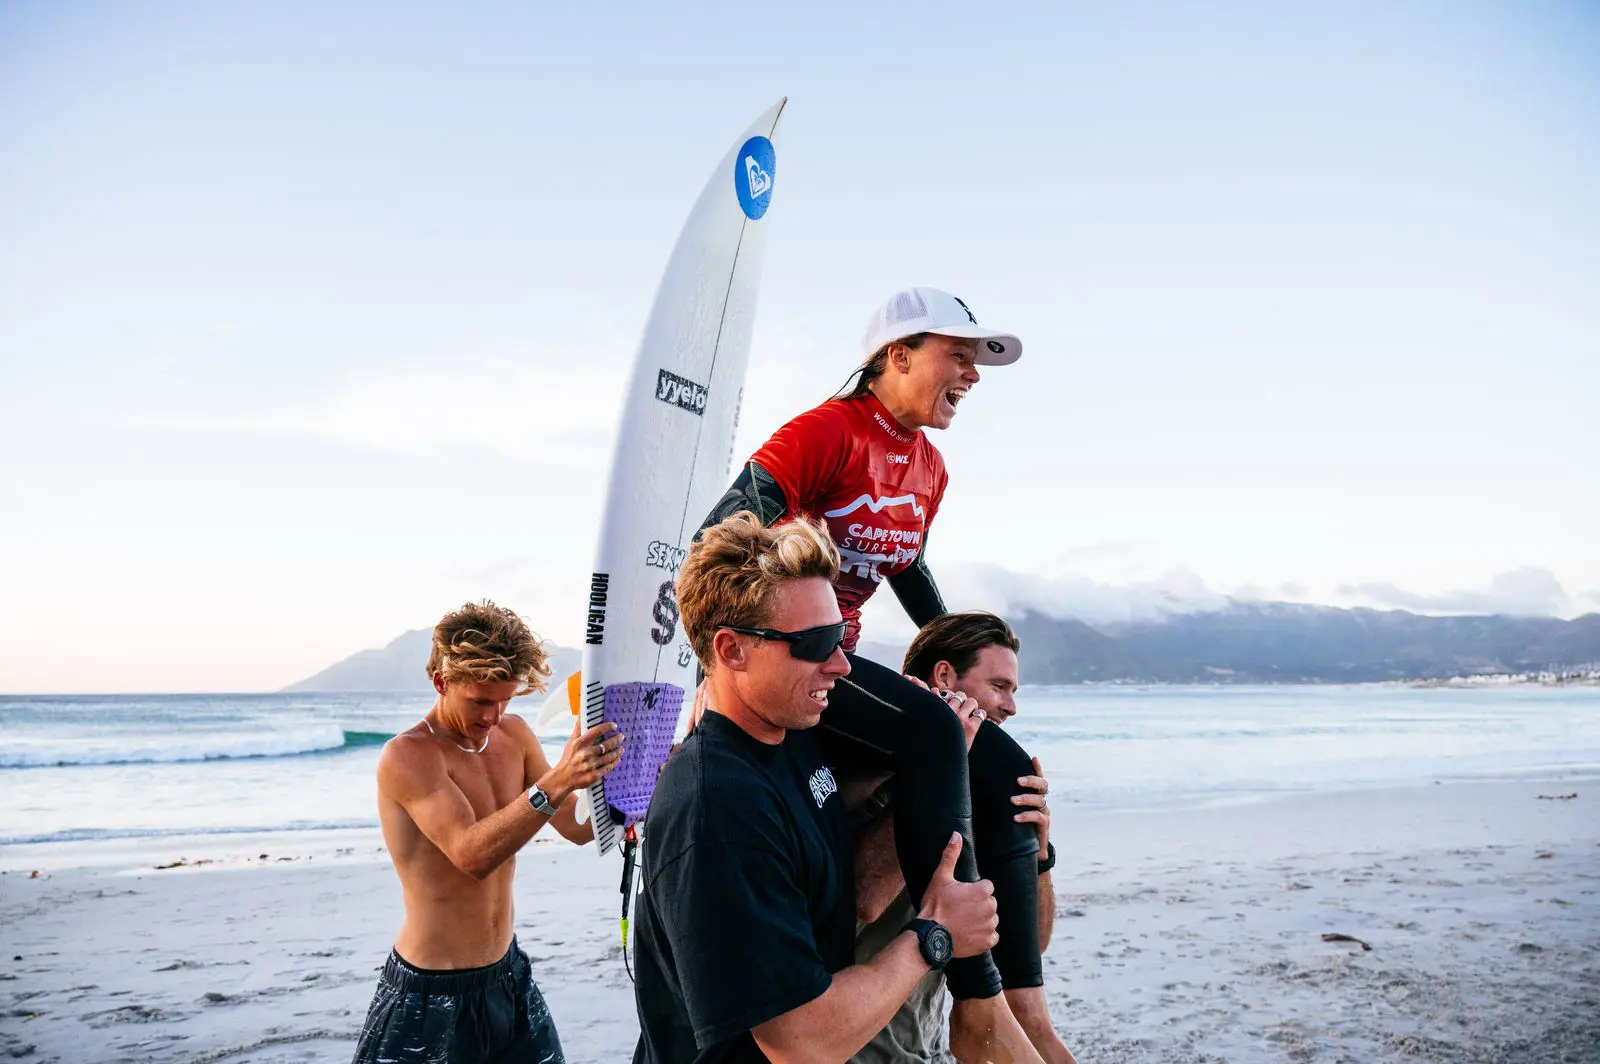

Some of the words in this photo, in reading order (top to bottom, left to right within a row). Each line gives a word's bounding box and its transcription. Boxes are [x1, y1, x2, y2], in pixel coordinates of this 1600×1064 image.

[873, 412, 897, 437] WORLD
[848, 523, 887, 542] CAPE
[887, 529, 921, 545] TOWN
[841, 538, 888, 553] SURF
